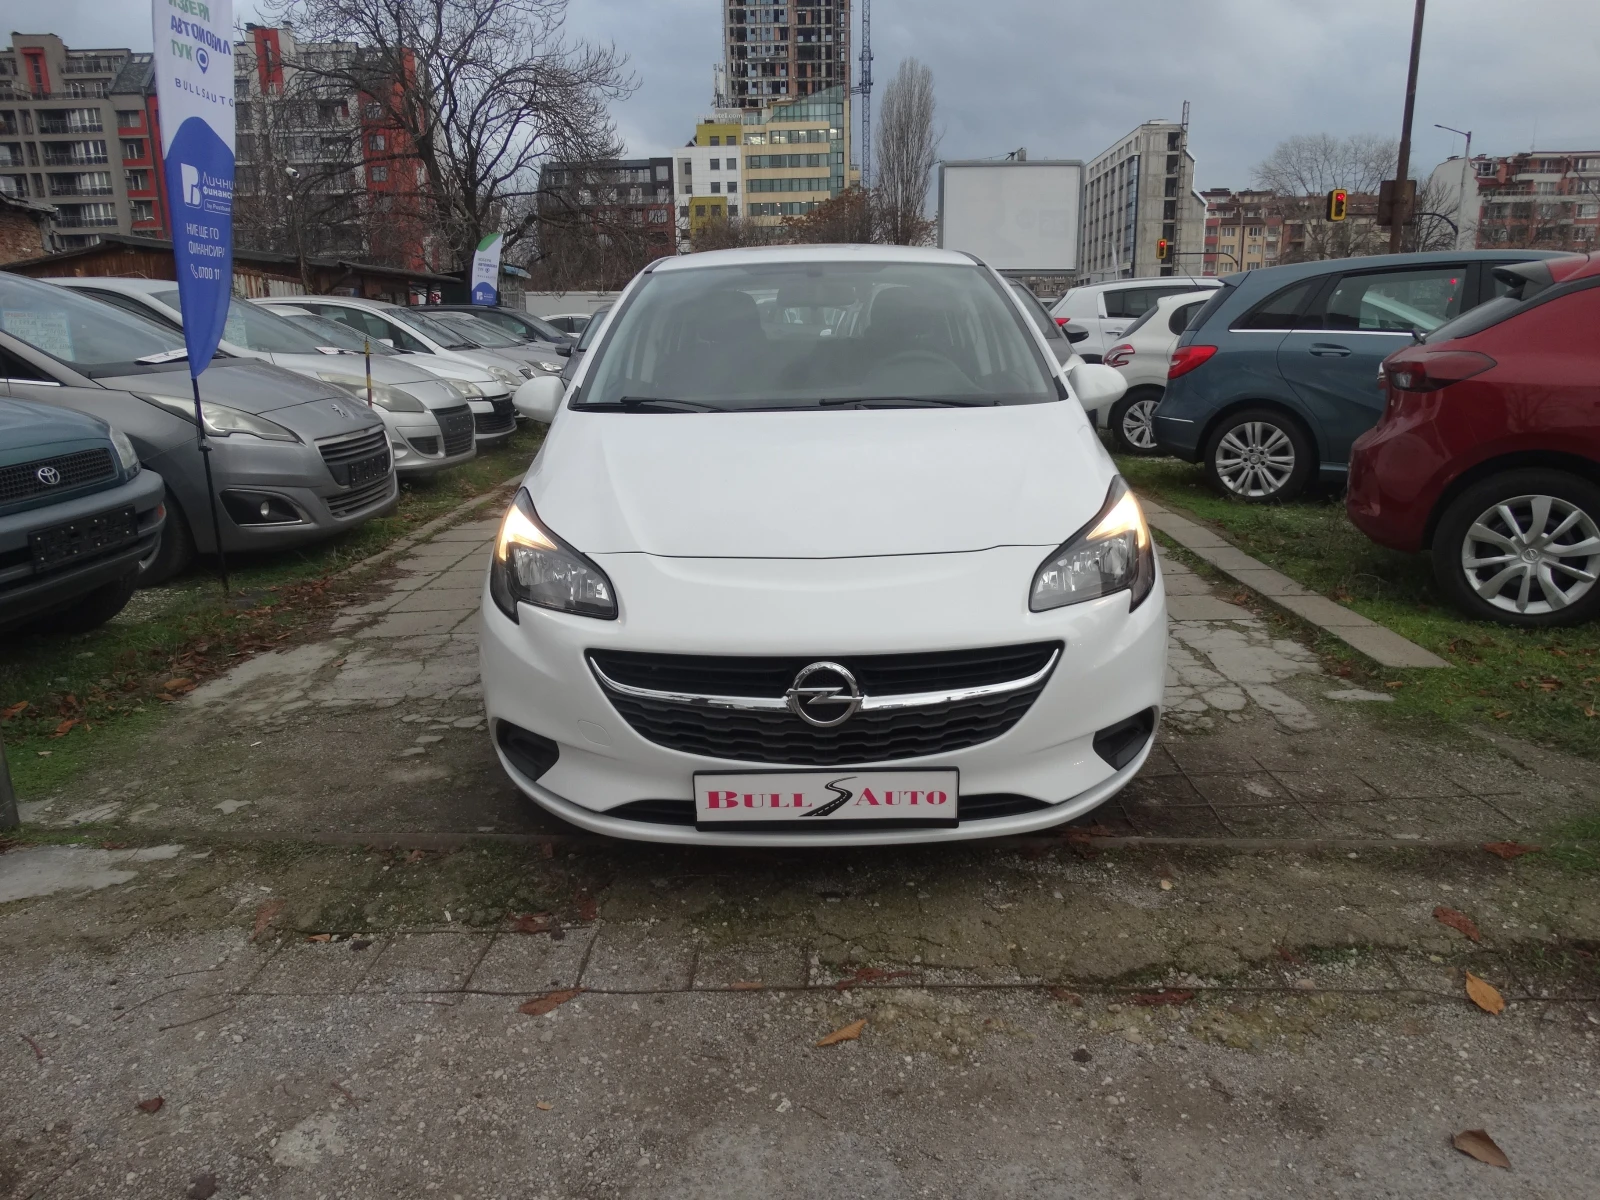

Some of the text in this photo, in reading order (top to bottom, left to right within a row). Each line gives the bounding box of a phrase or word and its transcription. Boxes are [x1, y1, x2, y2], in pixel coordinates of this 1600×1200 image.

[171, 39, 193, 61] ТУК
[175, 78, 233, 107] BULLSAUTO
[210, 227, 220, 240] ГО
[198, 266, 213, 279] 0700
